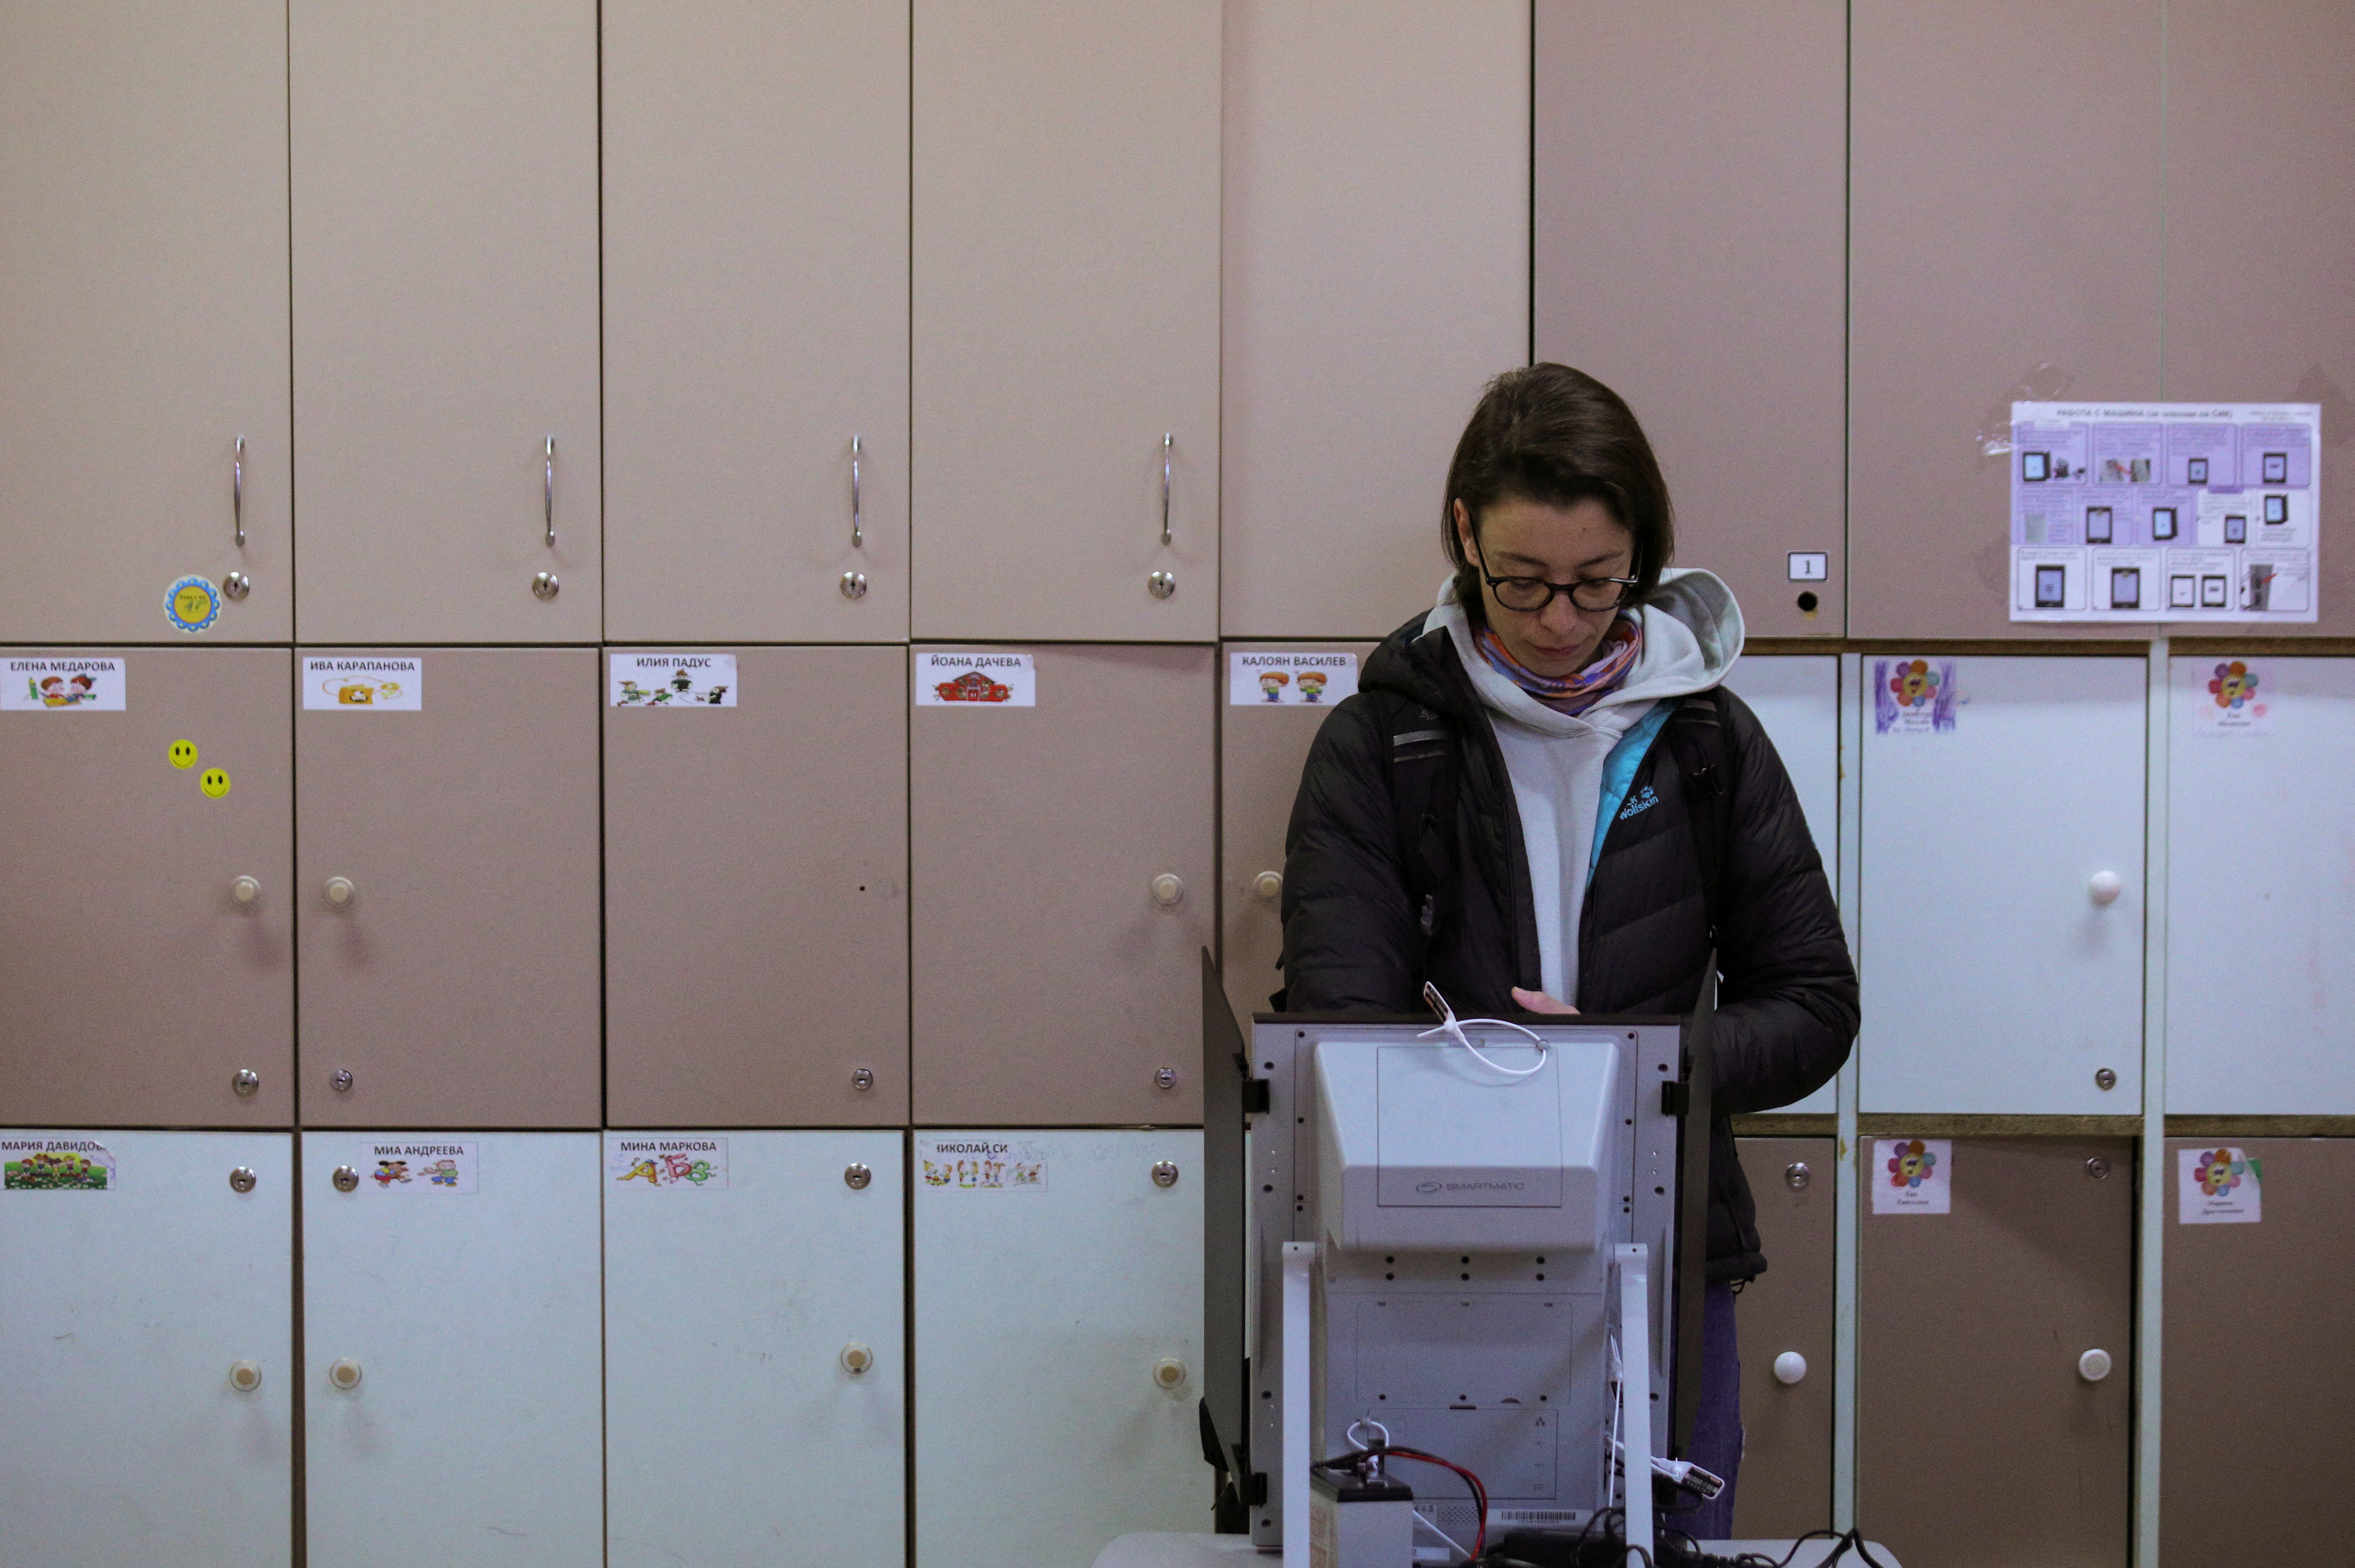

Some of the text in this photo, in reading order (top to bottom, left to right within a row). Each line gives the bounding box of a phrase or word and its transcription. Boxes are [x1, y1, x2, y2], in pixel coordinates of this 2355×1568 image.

[1803, 560, 1812, 574] 1
[310, 661, 415, 671] ИВА КАРАПАНОВА
[637, 658, 711, 668] ИЛИЯ ПАДУС
[931, 654, 1021, 668] ЙОАНА ДАЧЕВА
[1243, 656, 1346, 666] КАЛОЯН ВАСИЛЕВ
[10, 662, 115, 672] ЕЛЕНА МЕДАРОВА
[1619, 796, 1659, 820] Wolfskin
[2, 1141, 106, 1152] МАРИЯ ДАВИДОВ
[374, 1146, 464, 1157] МИА АНДРЕЕВА
[620, 1142, 716, 1151] МИНА МАРКОВА
[1446, 1182, 1525, 1190] SMARTMATIC
